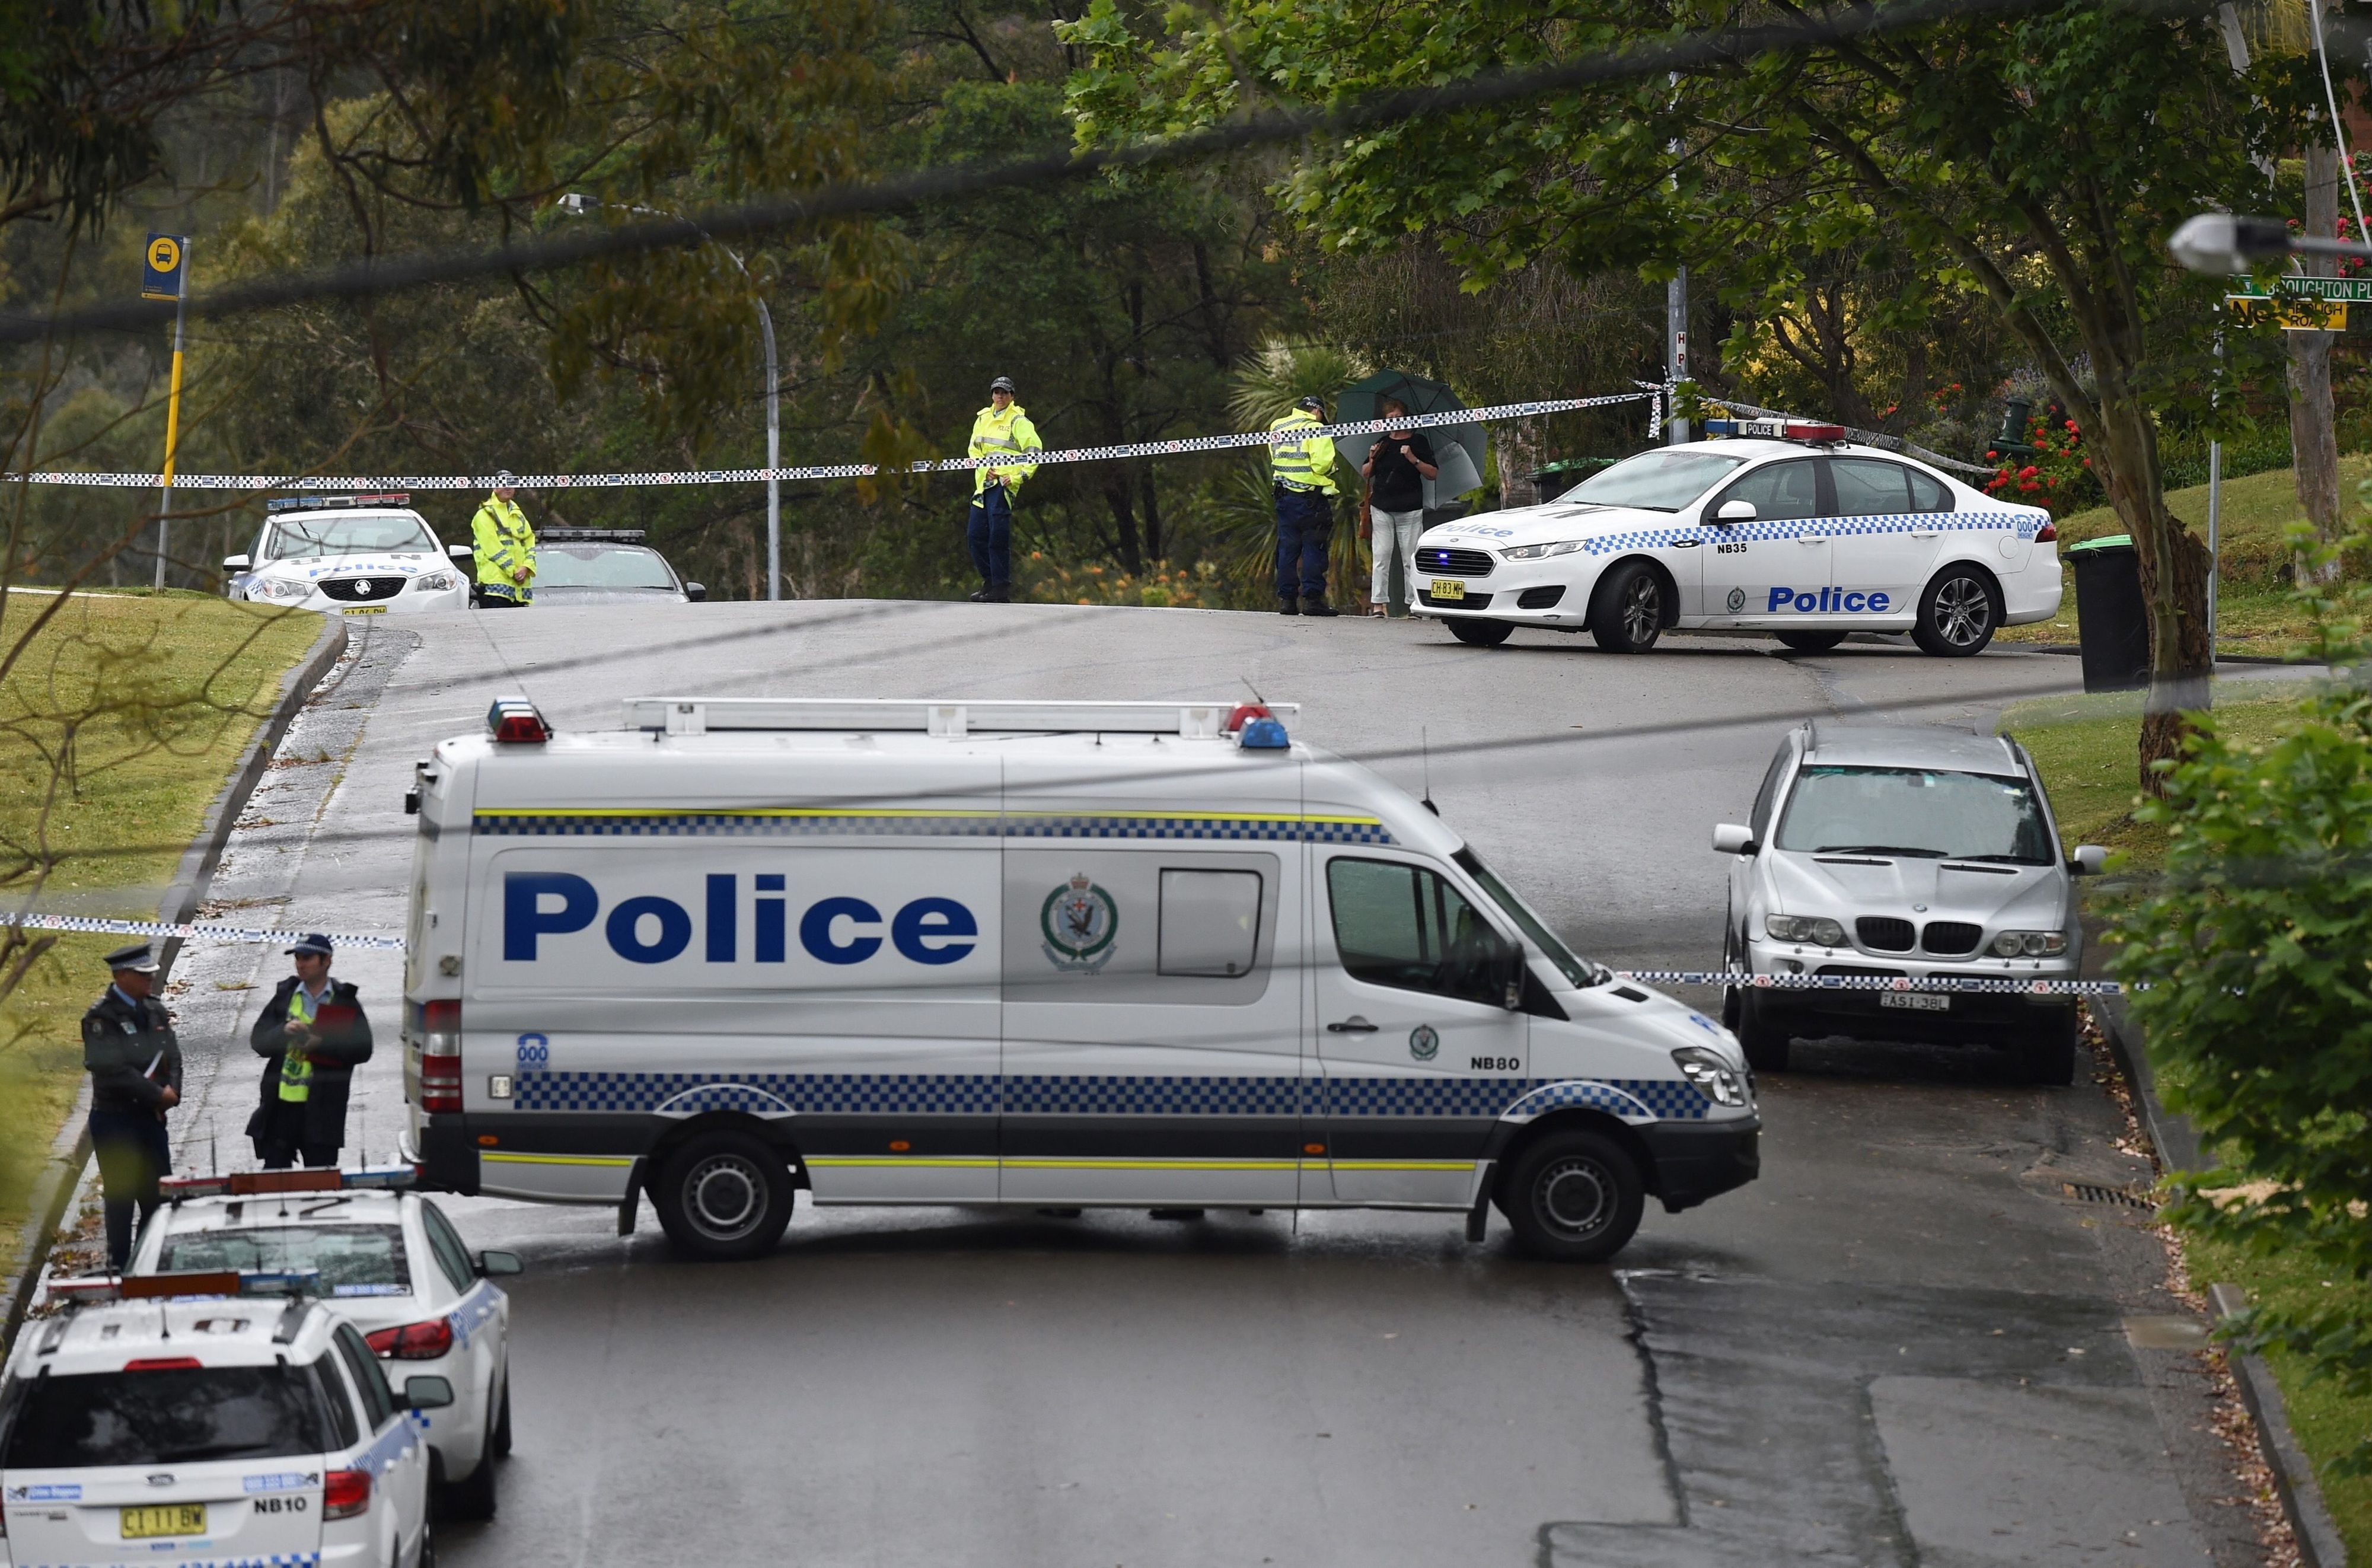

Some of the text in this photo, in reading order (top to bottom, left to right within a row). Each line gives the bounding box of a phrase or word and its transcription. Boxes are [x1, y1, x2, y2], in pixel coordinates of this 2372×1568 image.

[2357, 282, 2372, 299] PL
[1748, 423, 1772, 435] POLICE
[1430, 524, 1514, 537] Police
[2017, 521, 2033, 533] 000
[1717, 543, 1747, 554] NB35
[309, 564, 418, 577] Police
[1768, 587, 1890, 612] Police
[503, 871, 978, 965] Police
[518, 1046, 547, 1061] 000
[1471, 1057, 1520, 1070] NB80
[254, 1497, 307, 1513] NB10
